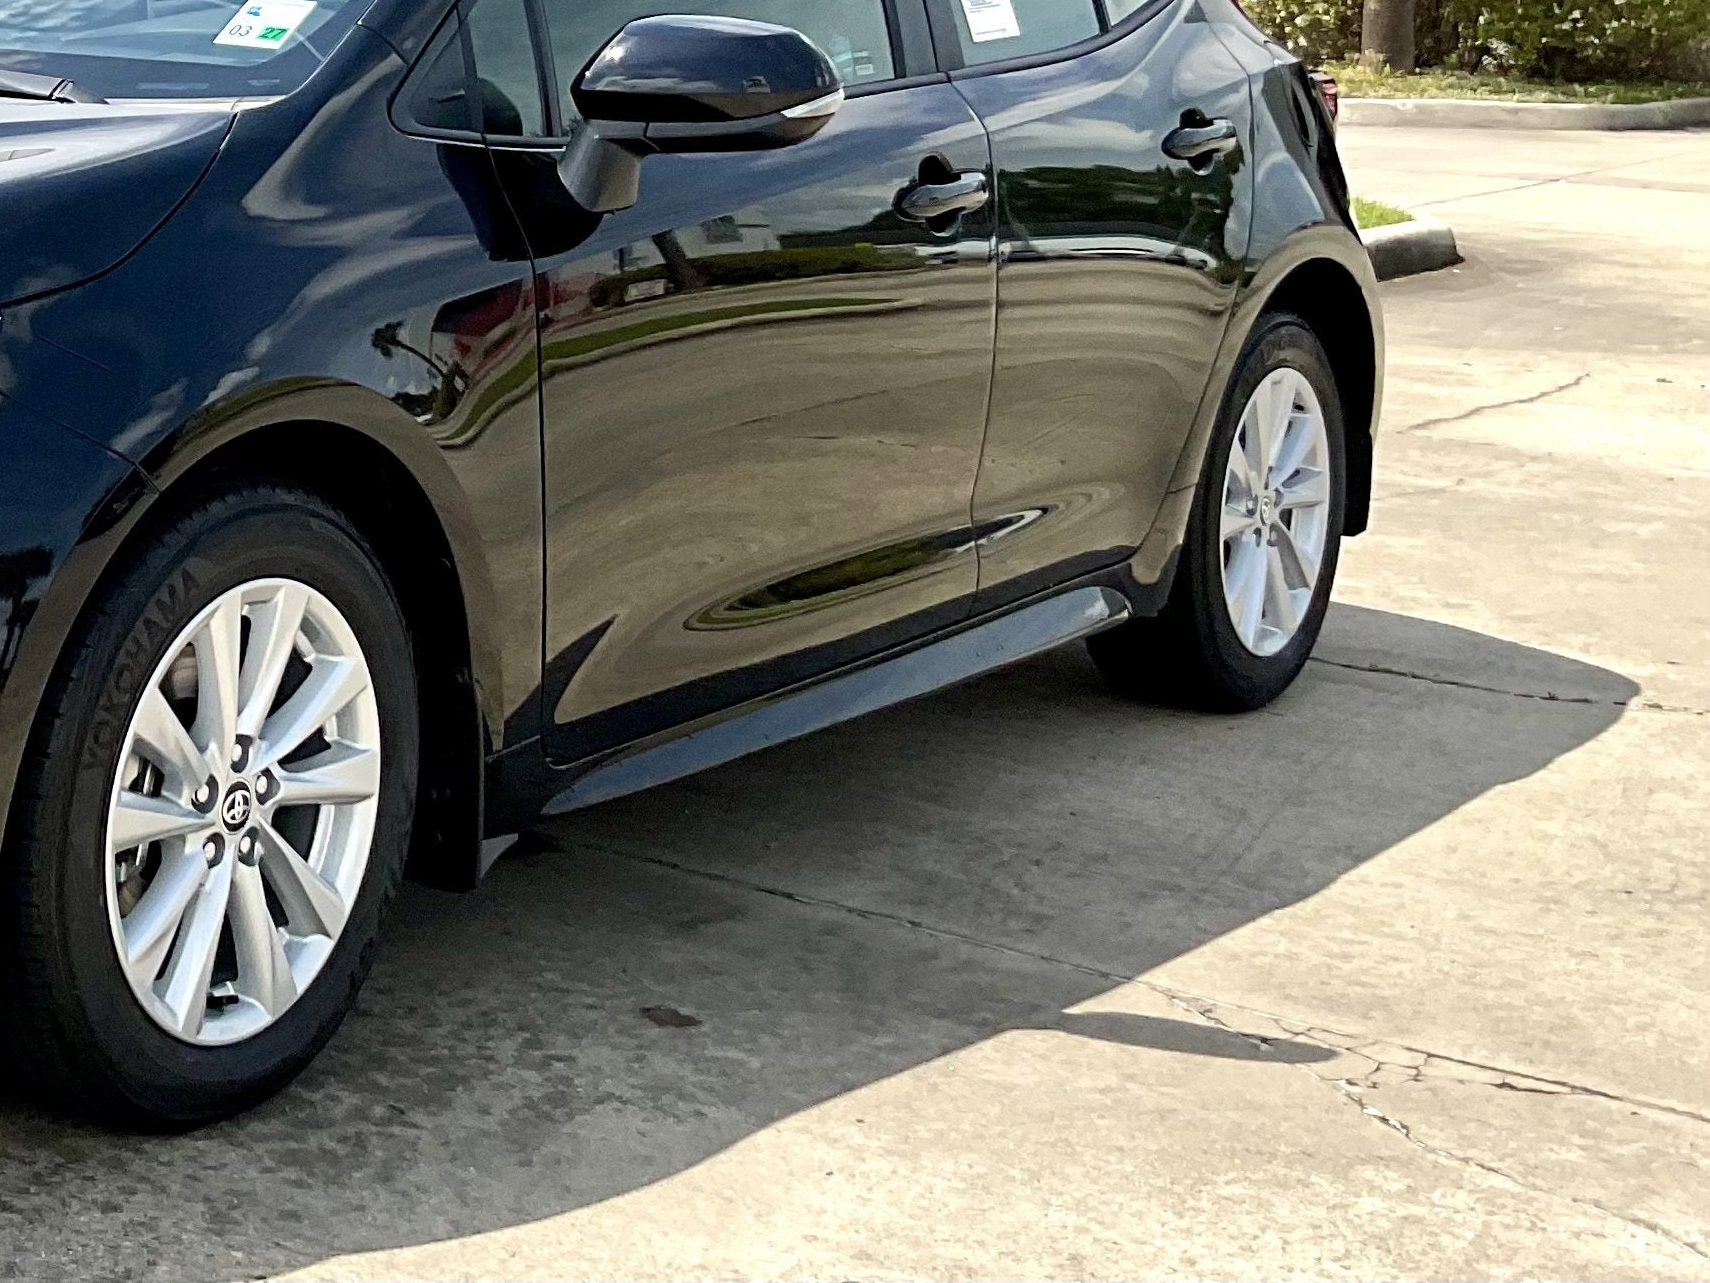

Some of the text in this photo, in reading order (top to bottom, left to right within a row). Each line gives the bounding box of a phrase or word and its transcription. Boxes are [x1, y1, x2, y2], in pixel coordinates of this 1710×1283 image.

[229, 24, 289, 39] 03 27
[84, 565, 201, 767] YOKOHAMA
